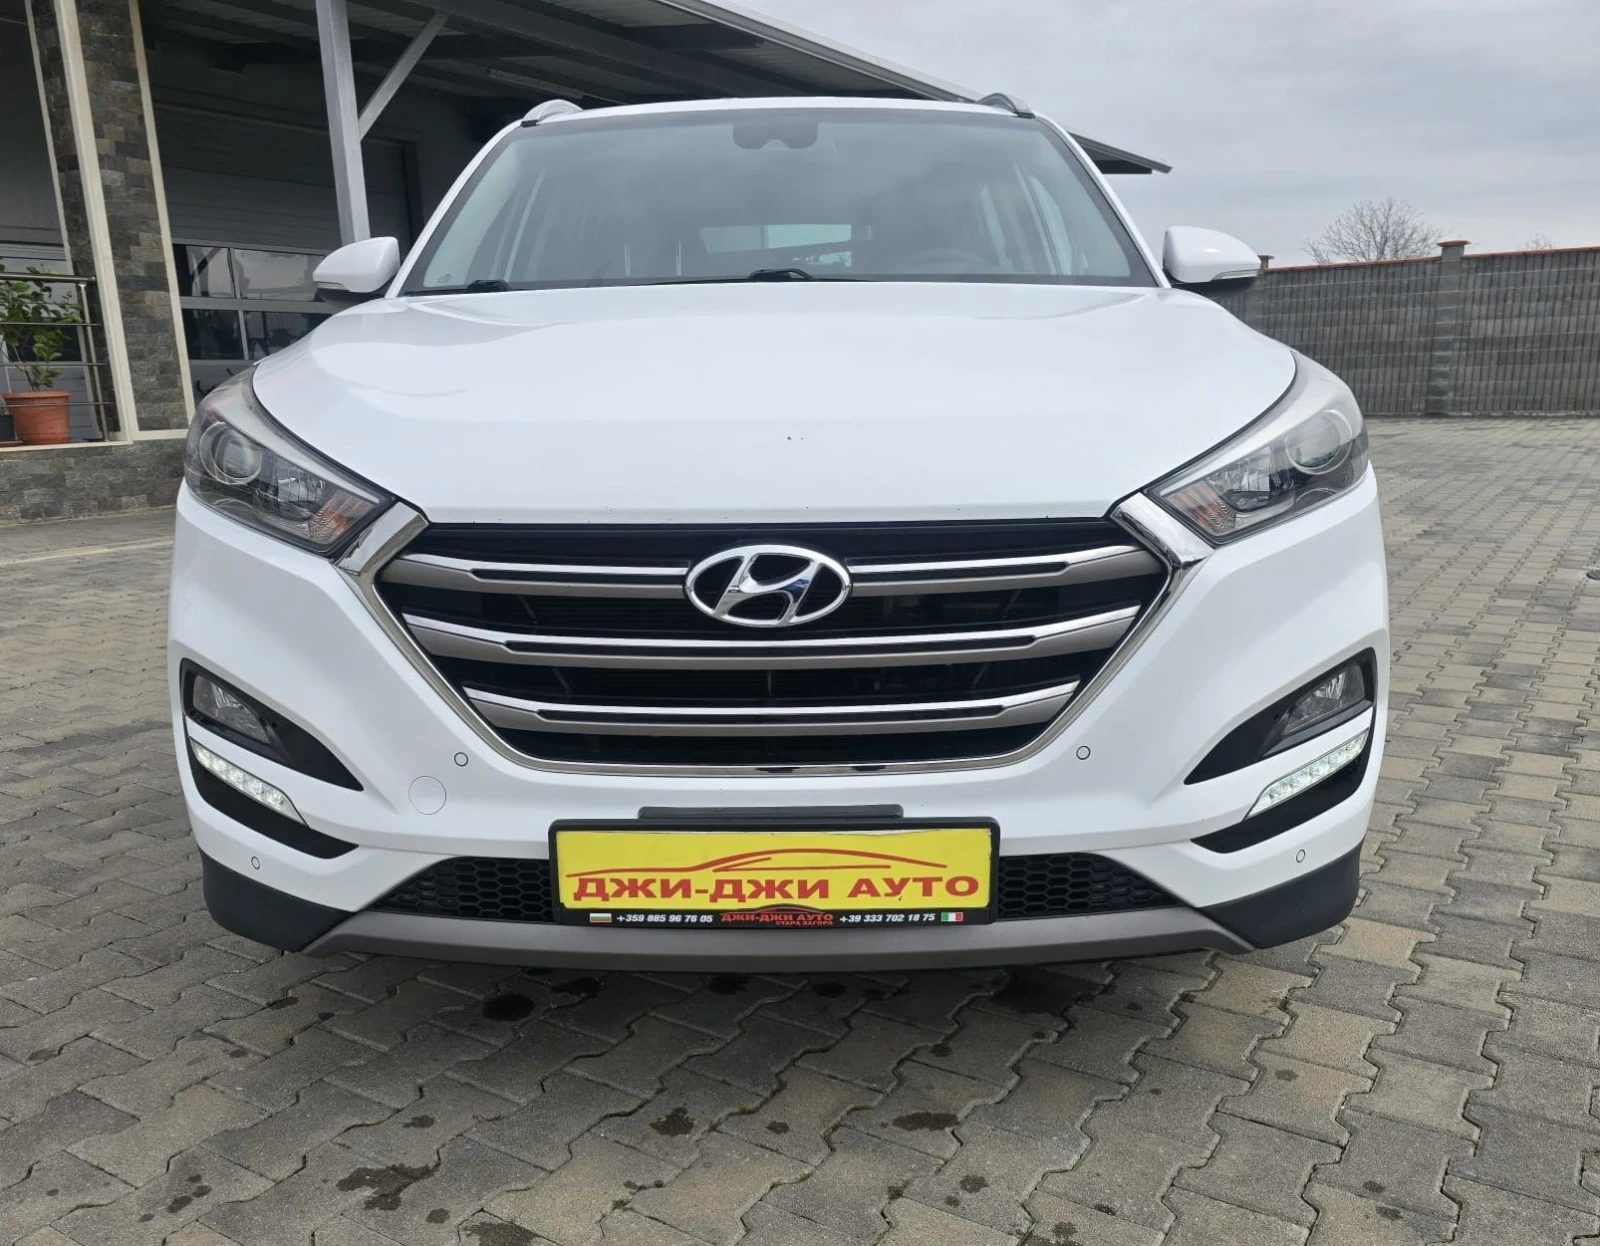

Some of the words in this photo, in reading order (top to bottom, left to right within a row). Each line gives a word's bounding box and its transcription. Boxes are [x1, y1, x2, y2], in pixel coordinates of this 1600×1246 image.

[573, 877, 829, 903] ДЖИ-ДЖИ
[847, 876, 979, 898] АУТО
[616, 914, 645, 923] +359
[647, 914, 667, 923] 885
[668, 914, 683, 923] 96
[685, 914, 698, 923] 76
[699, 914, 714, 923] 05
[721, 913, 794, 922] ДЖИ-ДЖИ
[796, 913, 834, 921] АУТО
[839, 914, 861, 923] +39
[863, 914, 883, 923] 333
[885, 914, 905, 922] 702
[907, 913, 920, 922] 18
[922, 913, 936, 921] 75
